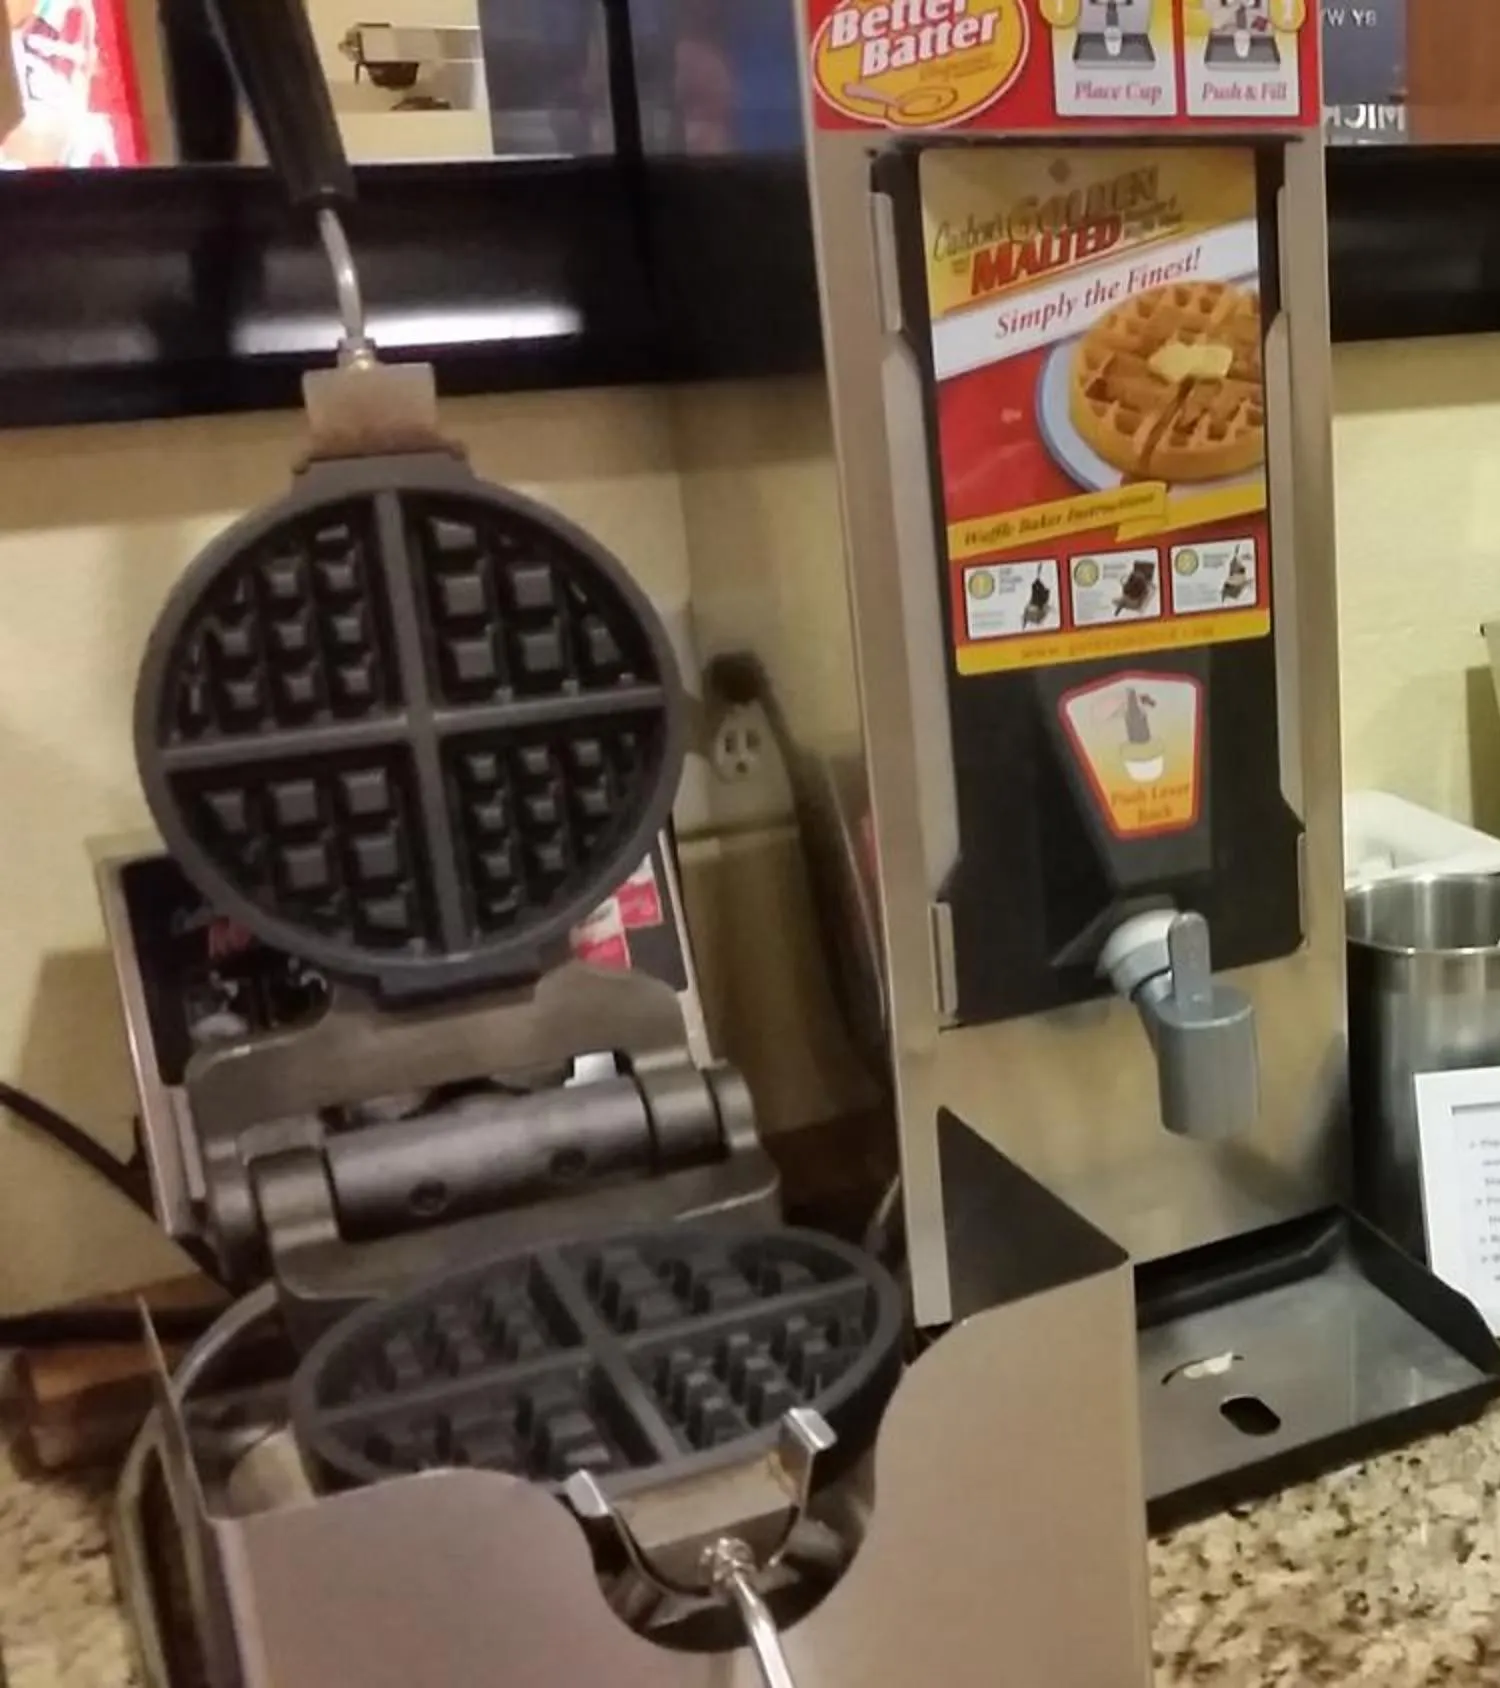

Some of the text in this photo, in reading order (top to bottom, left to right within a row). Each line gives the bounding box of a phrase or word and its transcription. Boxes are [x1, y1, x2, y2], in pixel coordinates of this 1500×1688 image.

[861, 12, 999, 77] Batter
[1075, 81, 1163, 104] Place Cup
[1202, 81, 1243, 101] Push
[1261, 81, 1287, 100] Fill
[970, 210, 1123, 296] MALTED
[996, 246, 1202, 338] Simply the Finest!
[964, 520, 1017, 547] Waffle
[1019, 513, 1062, 534] Baker
